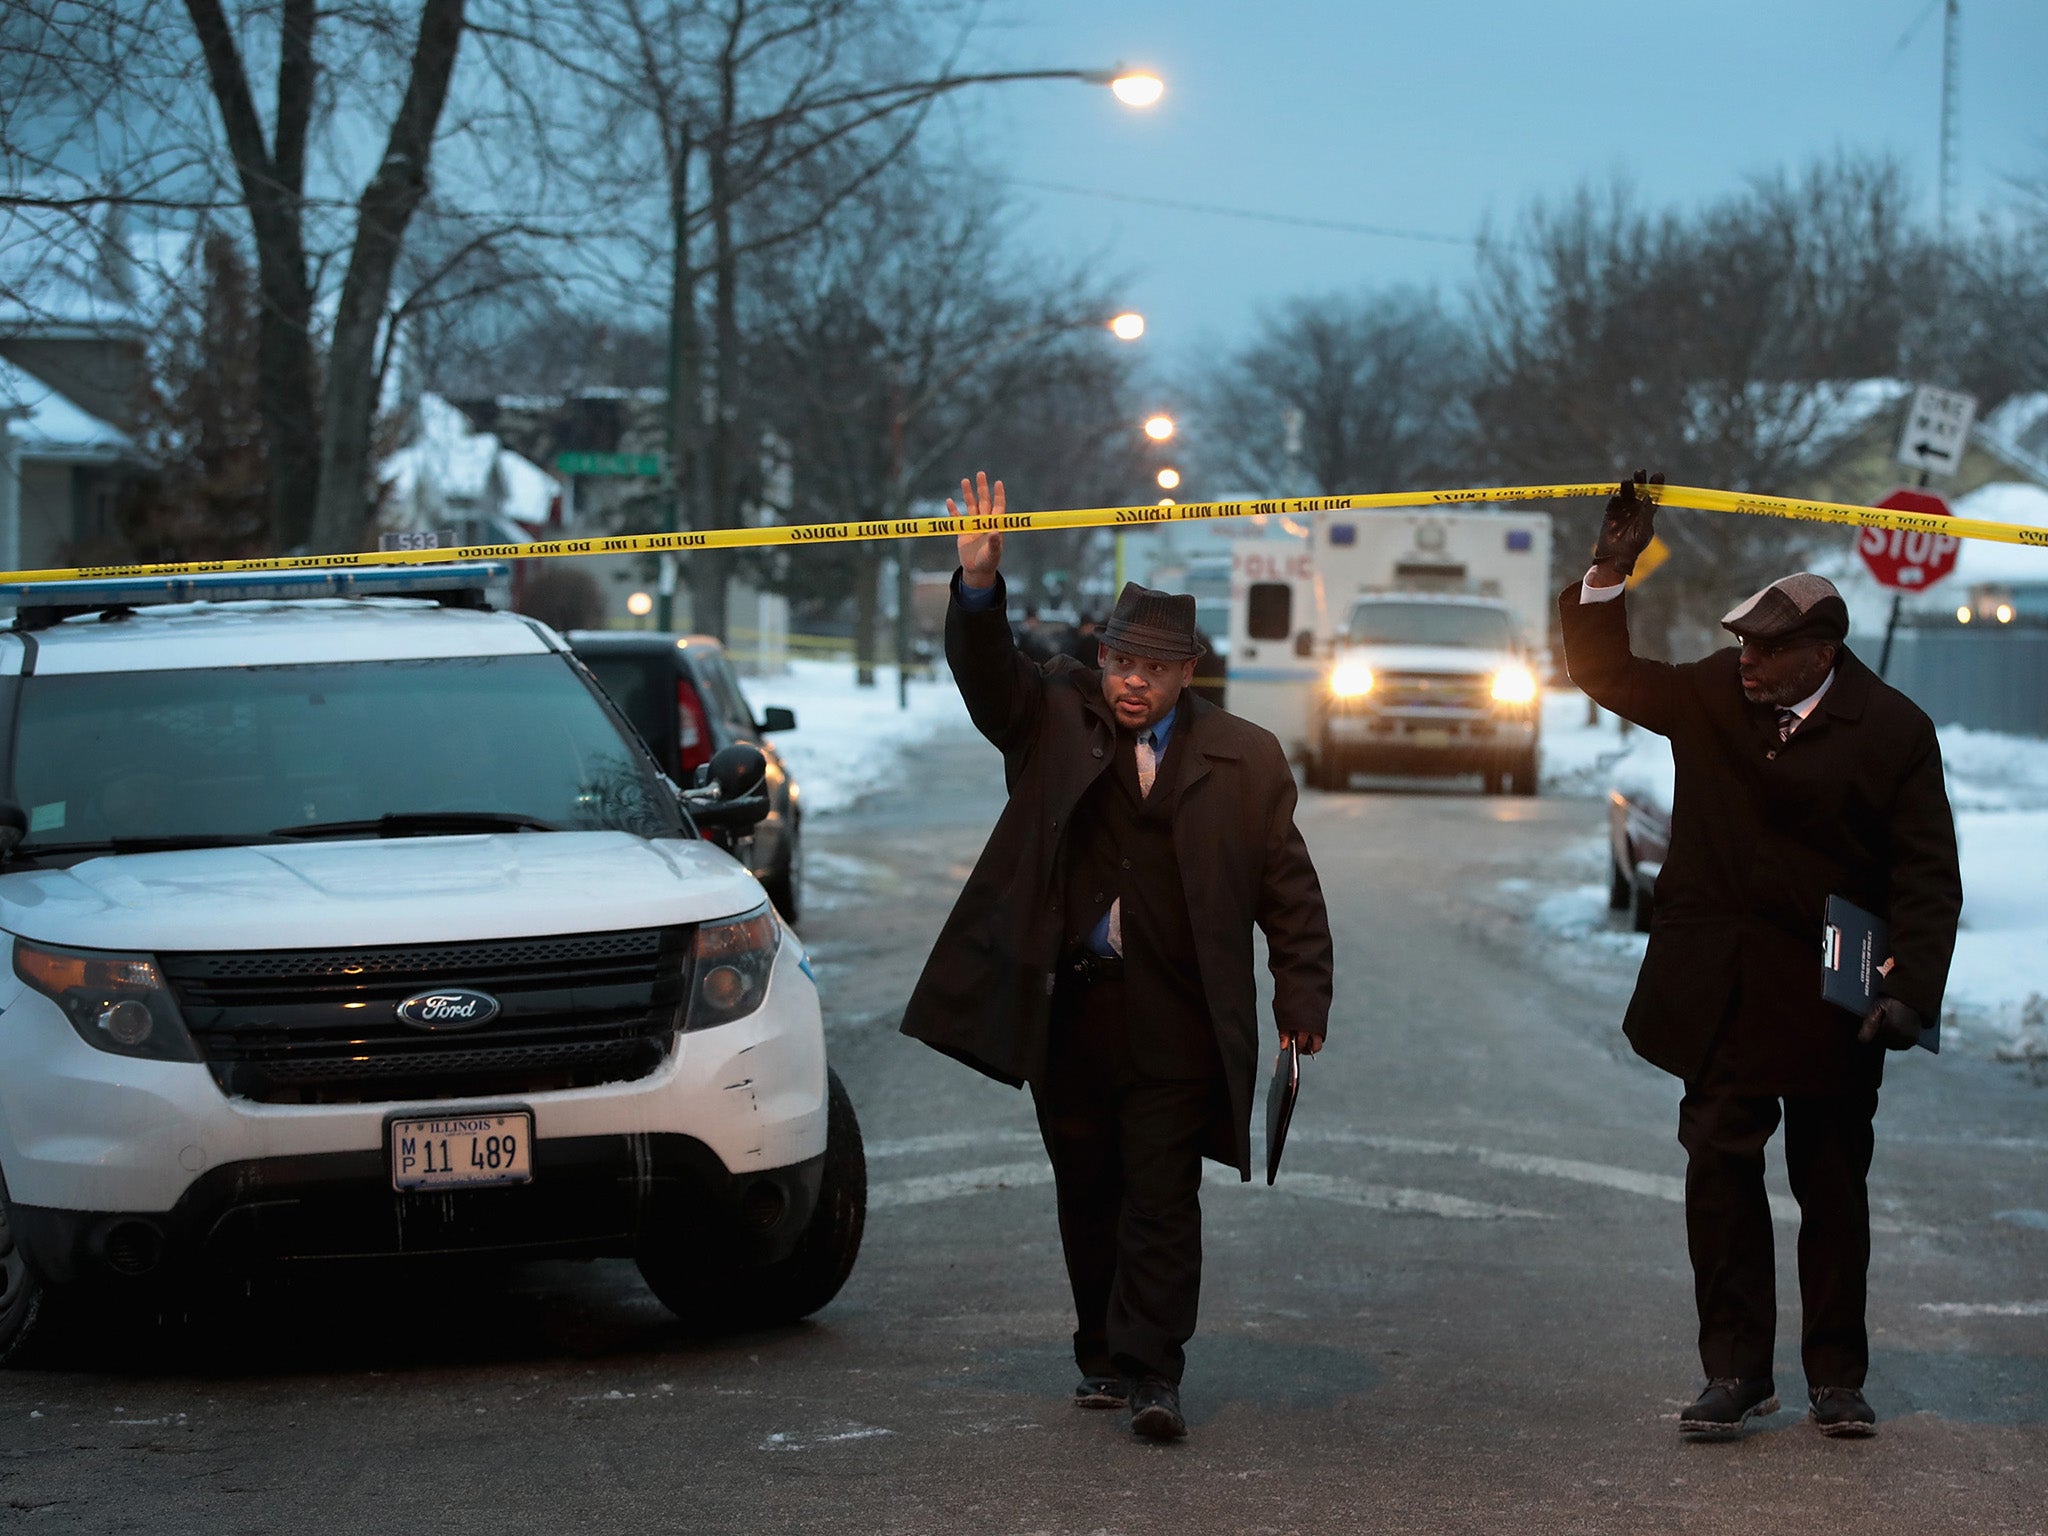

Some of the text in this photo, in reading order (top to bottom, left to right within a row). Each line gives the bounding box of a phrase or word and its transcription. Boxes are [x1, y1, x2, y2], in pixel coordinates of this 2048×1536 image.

[398, 532, 439, 551] 533
[1859, 526, 1958, 568] STOP
[422, 995, 476, 1020] Ford
[429, 1120, 491, 1134] ILLINOIS
[423, 1139, 453, 1174] 11
[471, 1134, 517, 1171] 489
